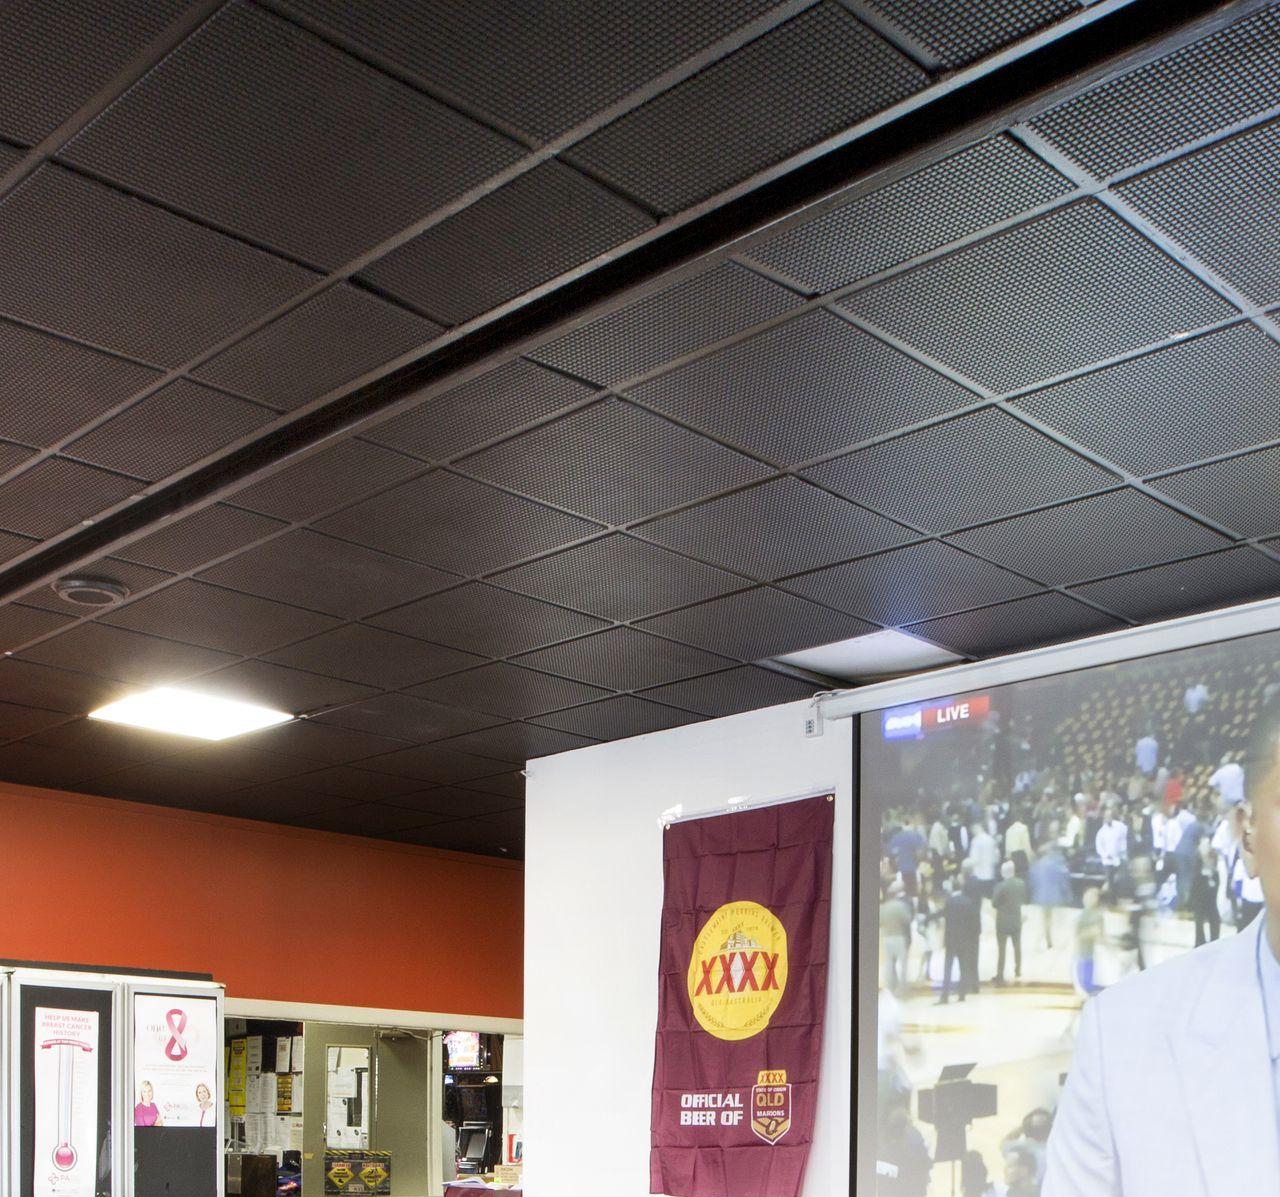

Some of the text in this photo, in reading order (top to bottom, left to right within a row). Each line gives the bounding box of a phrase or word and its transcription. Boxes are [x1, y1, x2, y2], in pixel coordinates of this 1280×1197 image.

[936, 703, 970, 723] LIVE
[695, 951, 780, 997] XXXX
[759, 1072, 784, 1084] XXXX
[681, 1093, 743, 1108] OFFICIAL
[756, 1093, 785, 1107] QLD
[680, 1110, 744, 1125] BEER OF
